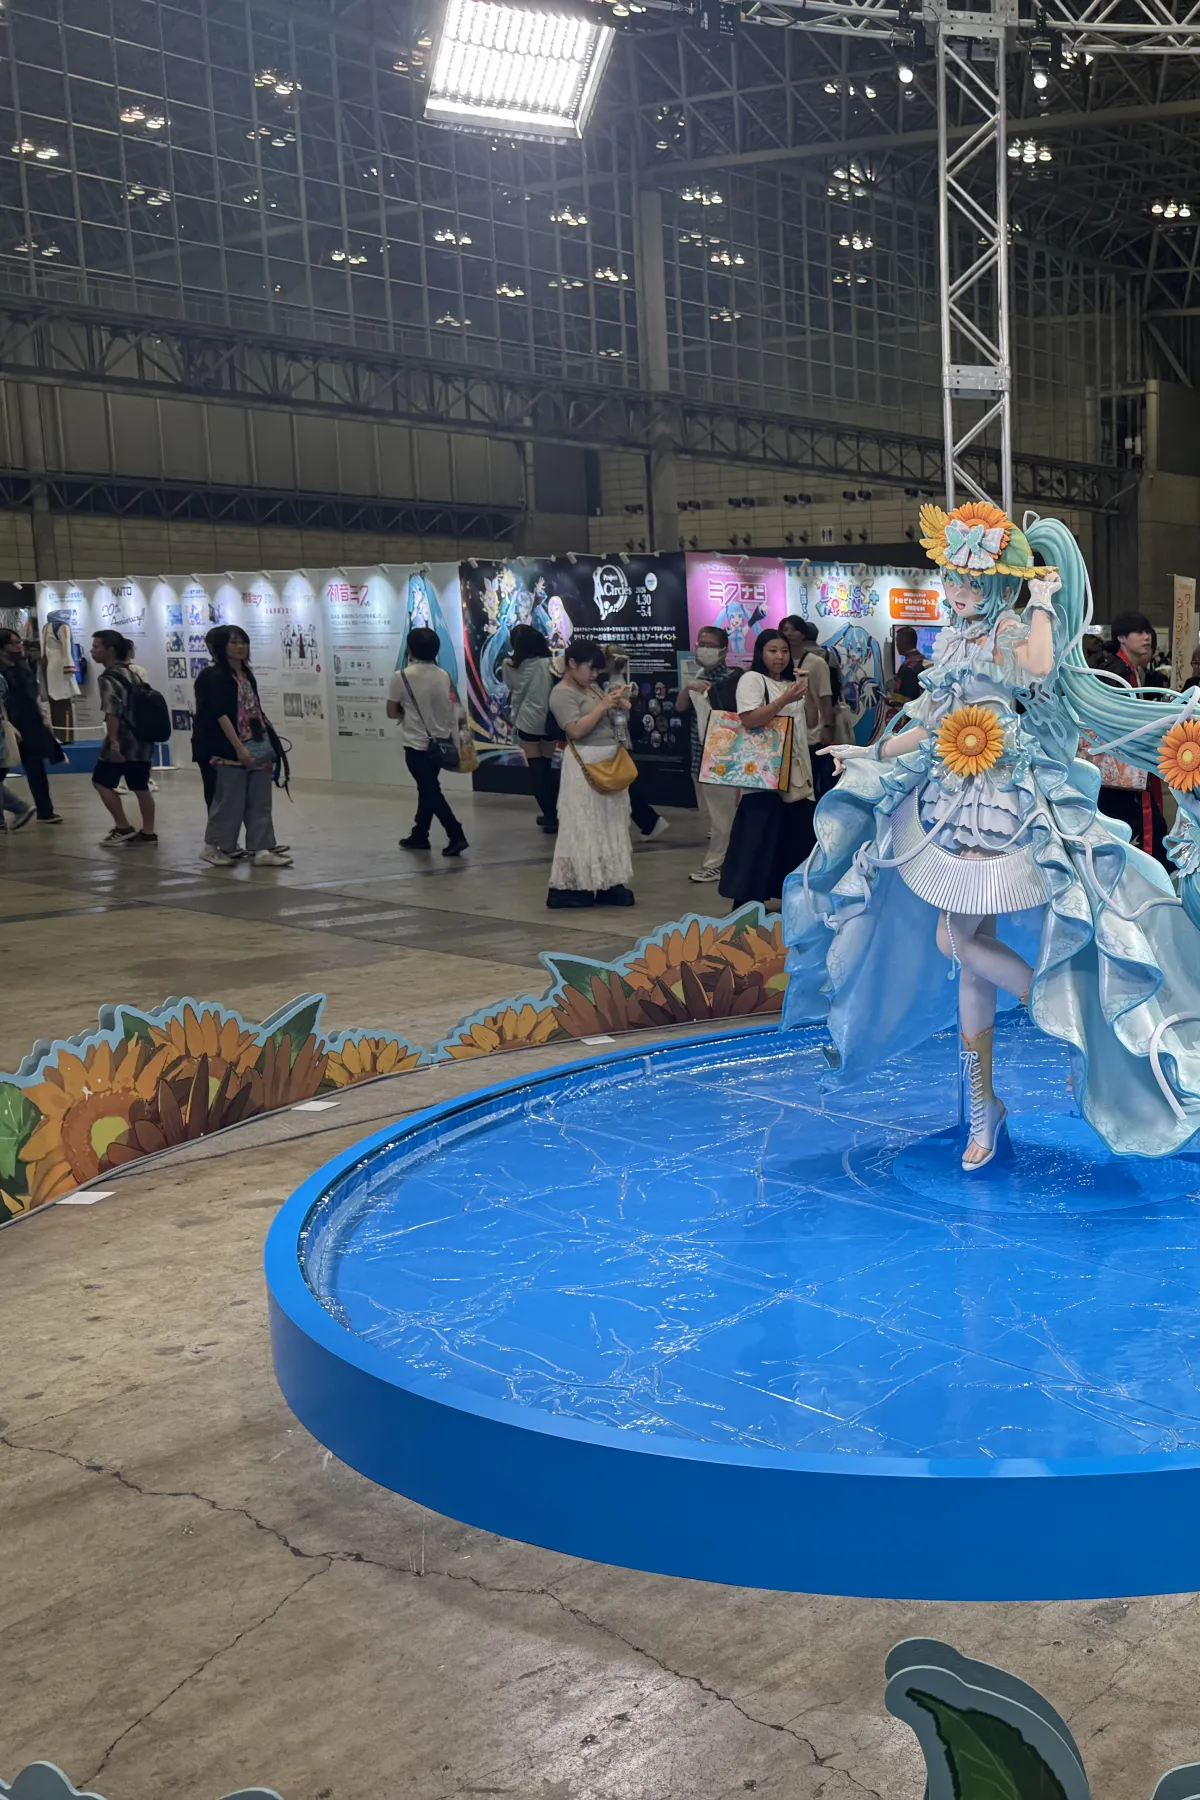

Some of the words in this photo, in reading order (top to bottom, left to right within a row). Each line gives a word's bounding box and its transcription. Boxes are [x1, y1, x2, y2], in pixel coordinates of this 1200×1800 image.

[603, 574, 618, 582] Project
[111, 586, 132, 597] KAITO
[326, 584, 369, 606] 初音ミク
